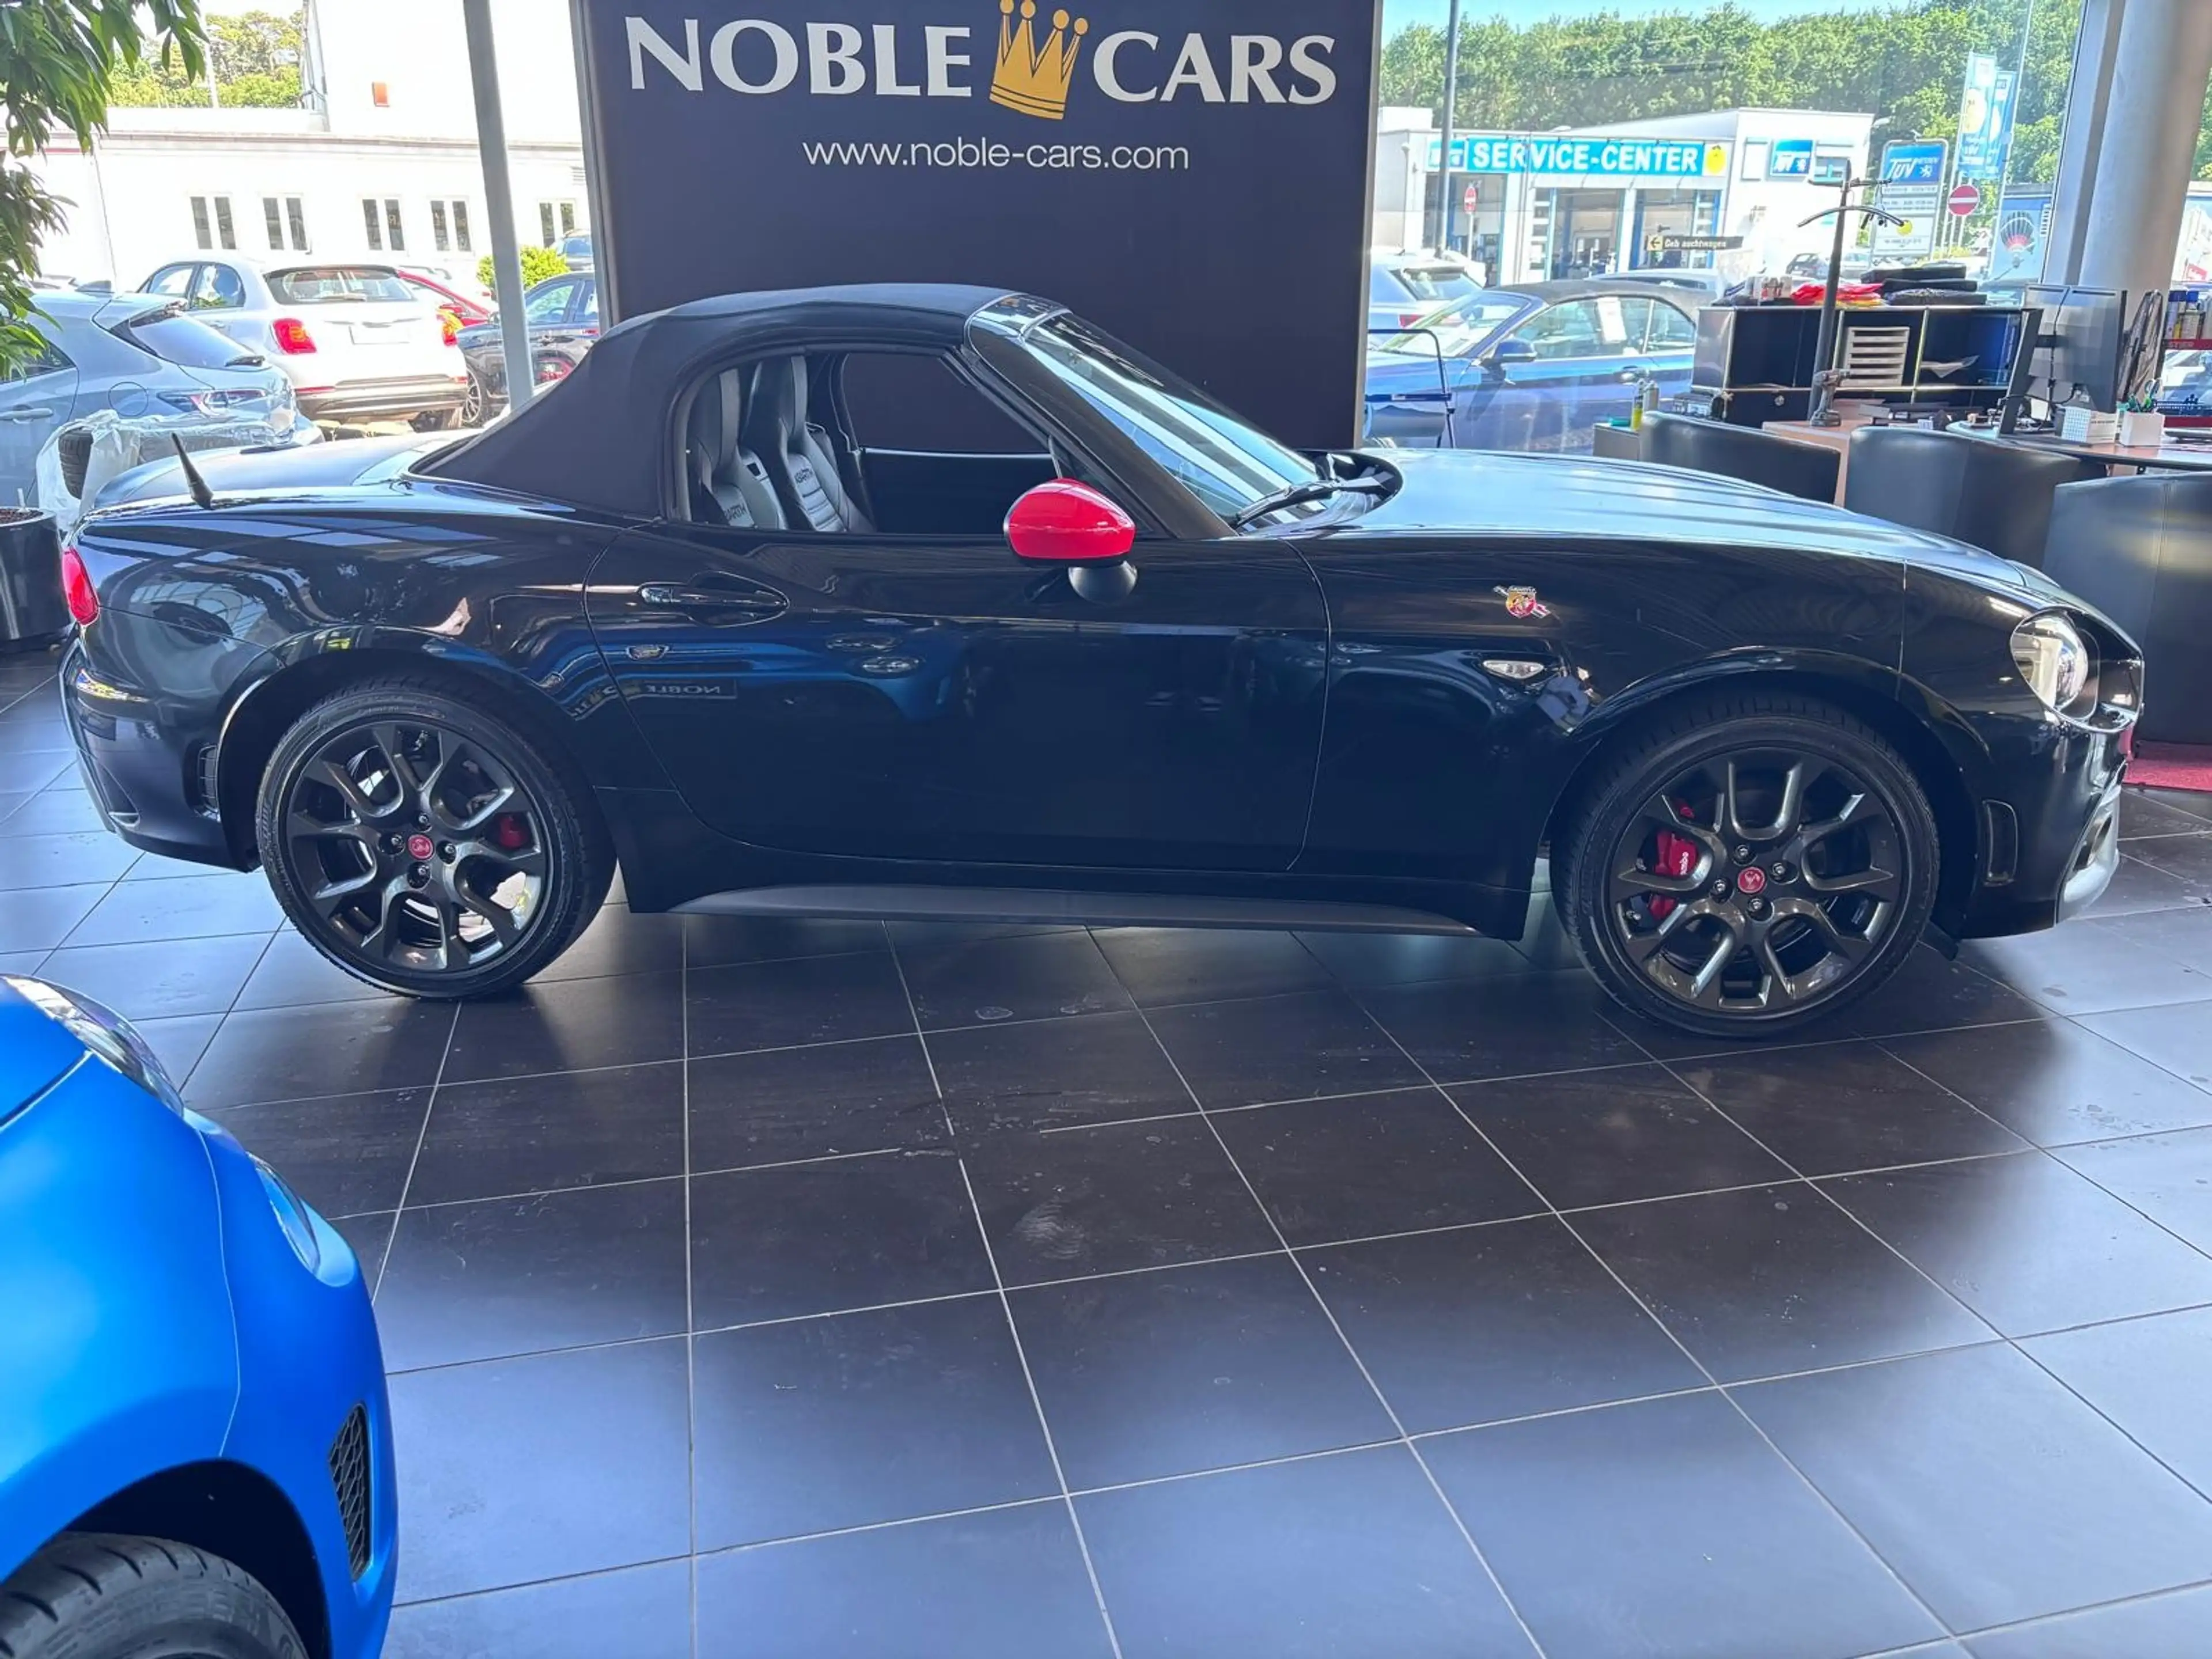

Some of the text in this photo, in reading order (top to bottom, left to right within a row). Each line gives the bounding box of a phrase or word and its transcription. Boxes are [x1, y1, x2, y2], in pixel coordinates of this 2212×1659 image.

[625, 16, 1337, 105] NOBLE CARS
[802, 136, 1189, 170] www.noble-cars.com
[1472, 141, 1699, 172] SERVICE-CENTER
